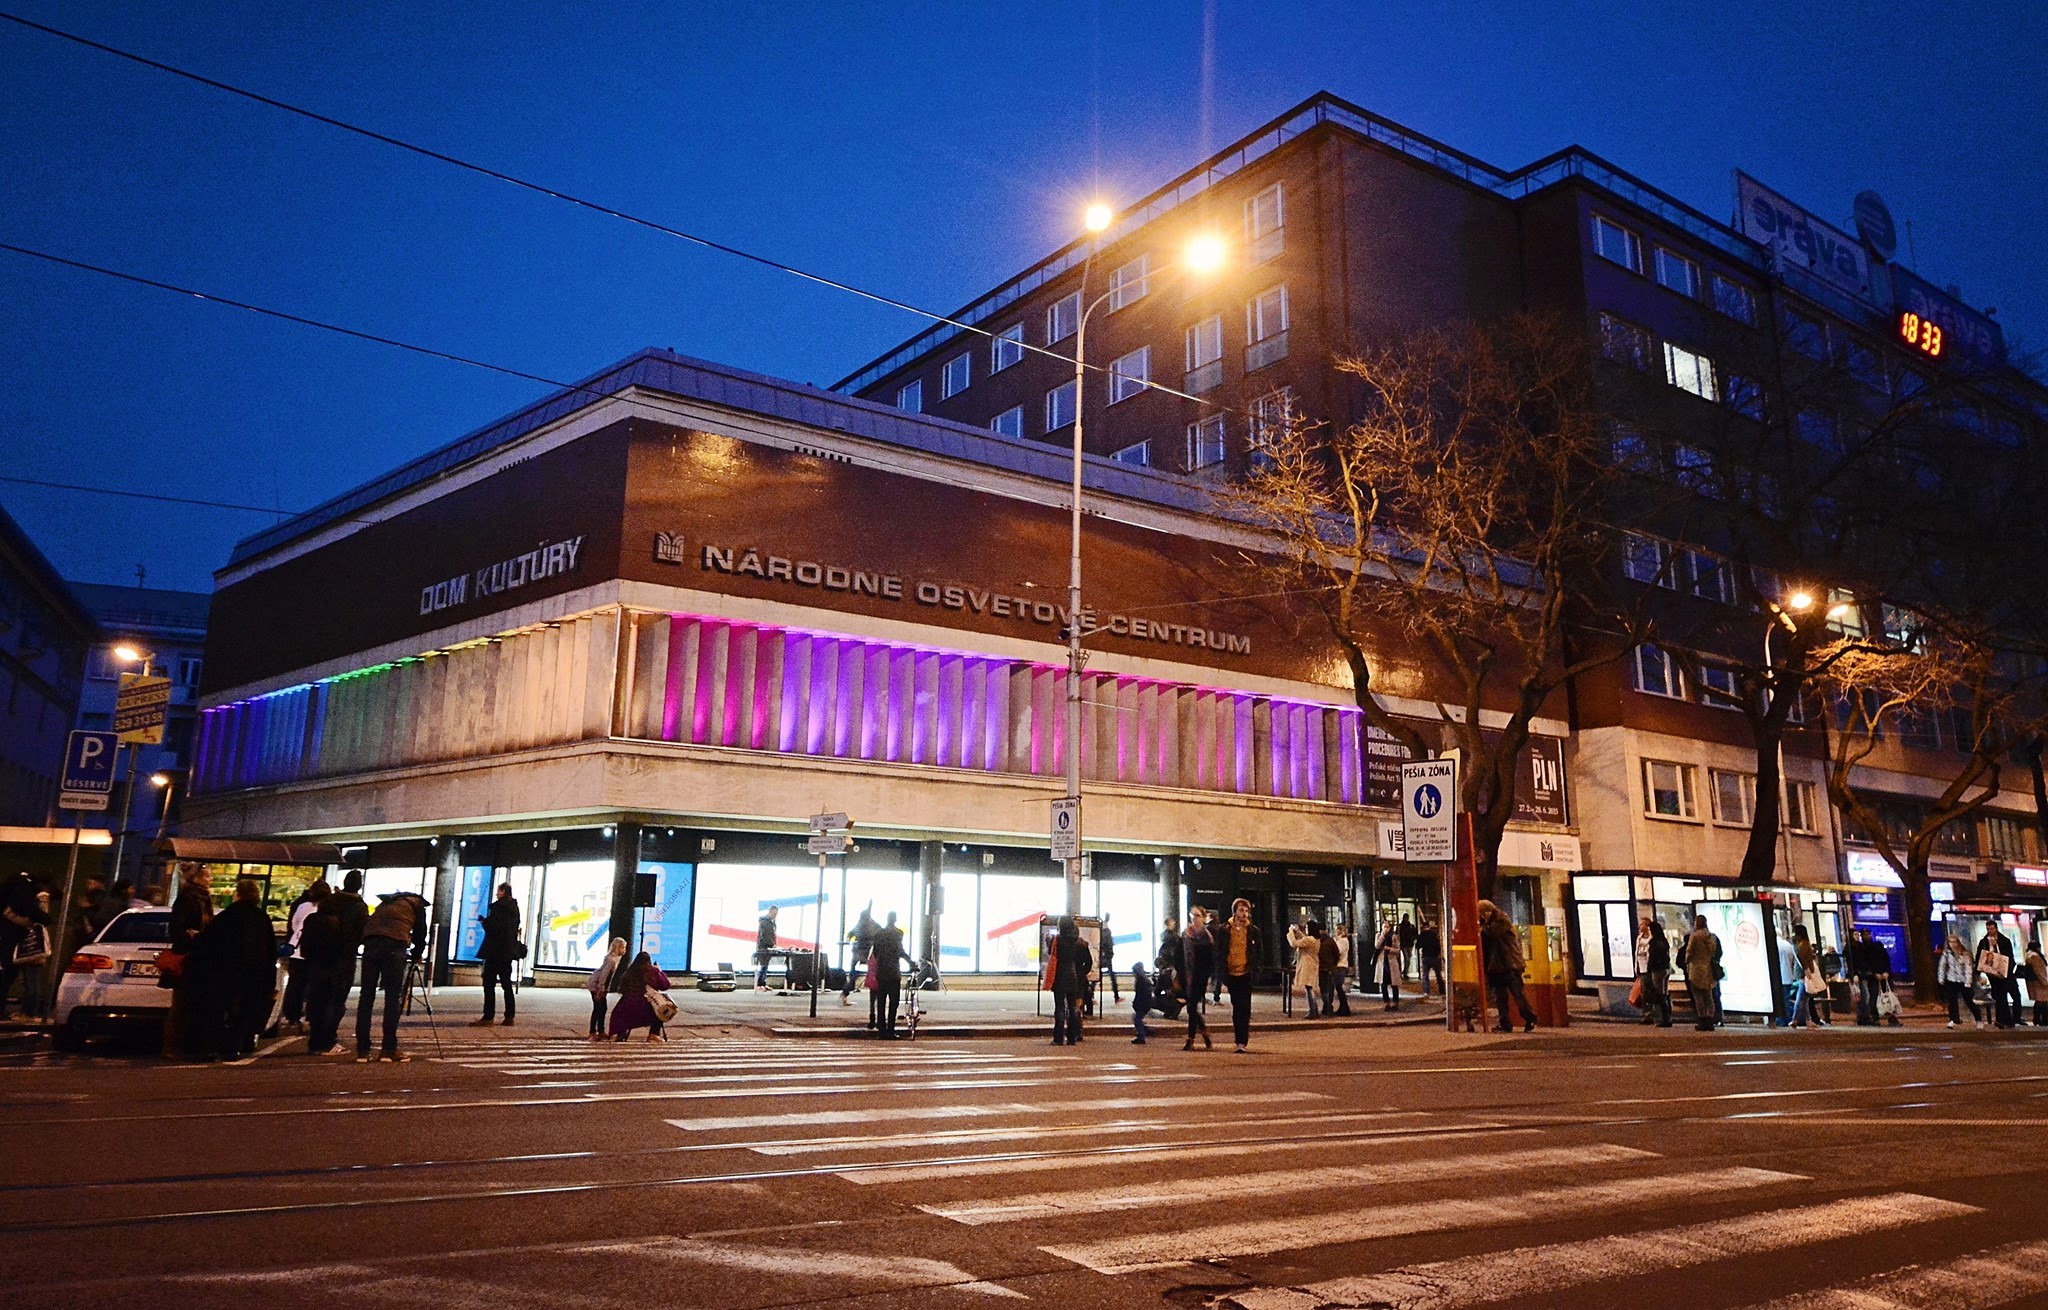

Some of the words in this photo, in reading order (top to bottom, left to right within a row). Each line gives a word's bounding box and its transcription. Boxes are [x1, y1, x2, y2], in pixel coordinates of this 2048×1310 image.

[420, 574, 470, 615] DOM
[703, 545, 903, 598] NÁRODNÉ
[916, 582, 1097, 629] OSVETOVÉ
[1107, 613, 1251, 655] CENTRUM
[80, 737, 104, 769] P
[1404, 765, 1426, 778] PEŠIA
[1428, 763, 1451, 777] ZÓNA
[1532, 758, 1558, 791] PLN
